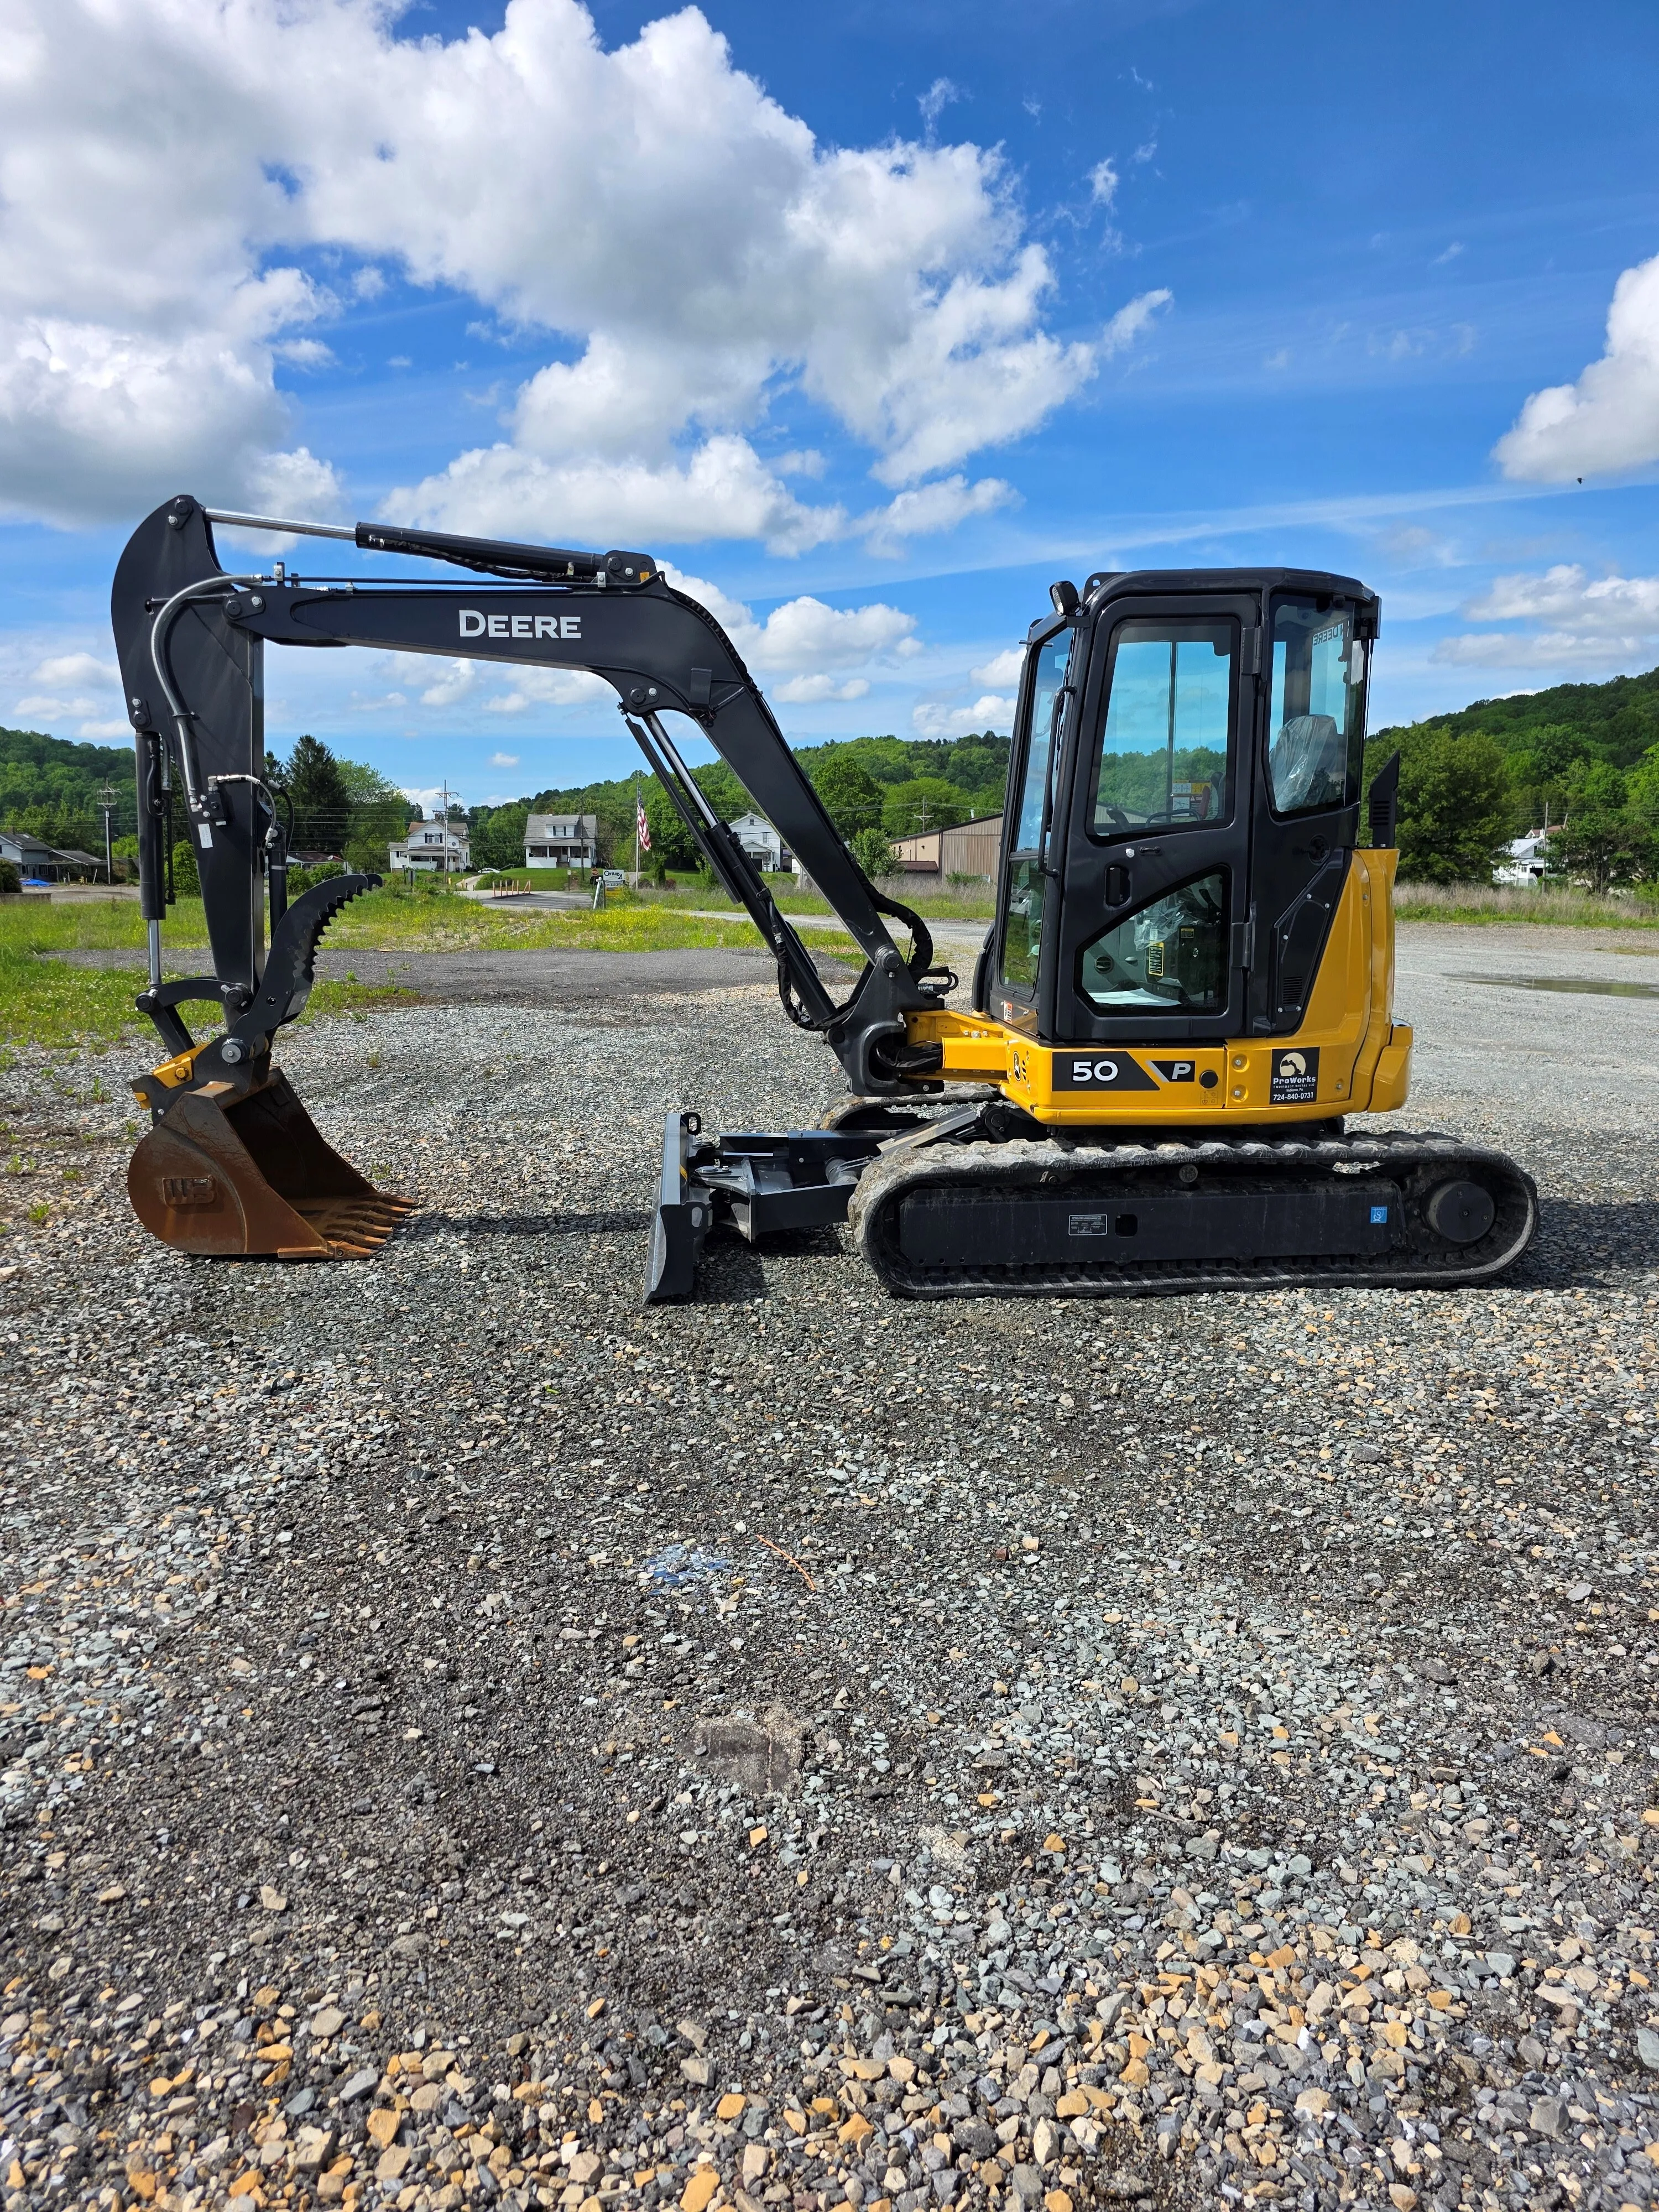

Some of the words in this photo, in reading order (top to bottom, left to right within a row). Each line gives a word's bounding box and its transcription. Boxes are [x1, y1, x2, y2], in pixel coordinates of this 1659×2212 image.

[459, 610, 581, 639] DEERE
[1073, 1061, 1118, 1081] 50
[1171, 1063, 1191, 1079] P
[1273, 1076, 1316, 1084] ProWorks
[1273, 1092, 1313, 1101] 724-840-0731
